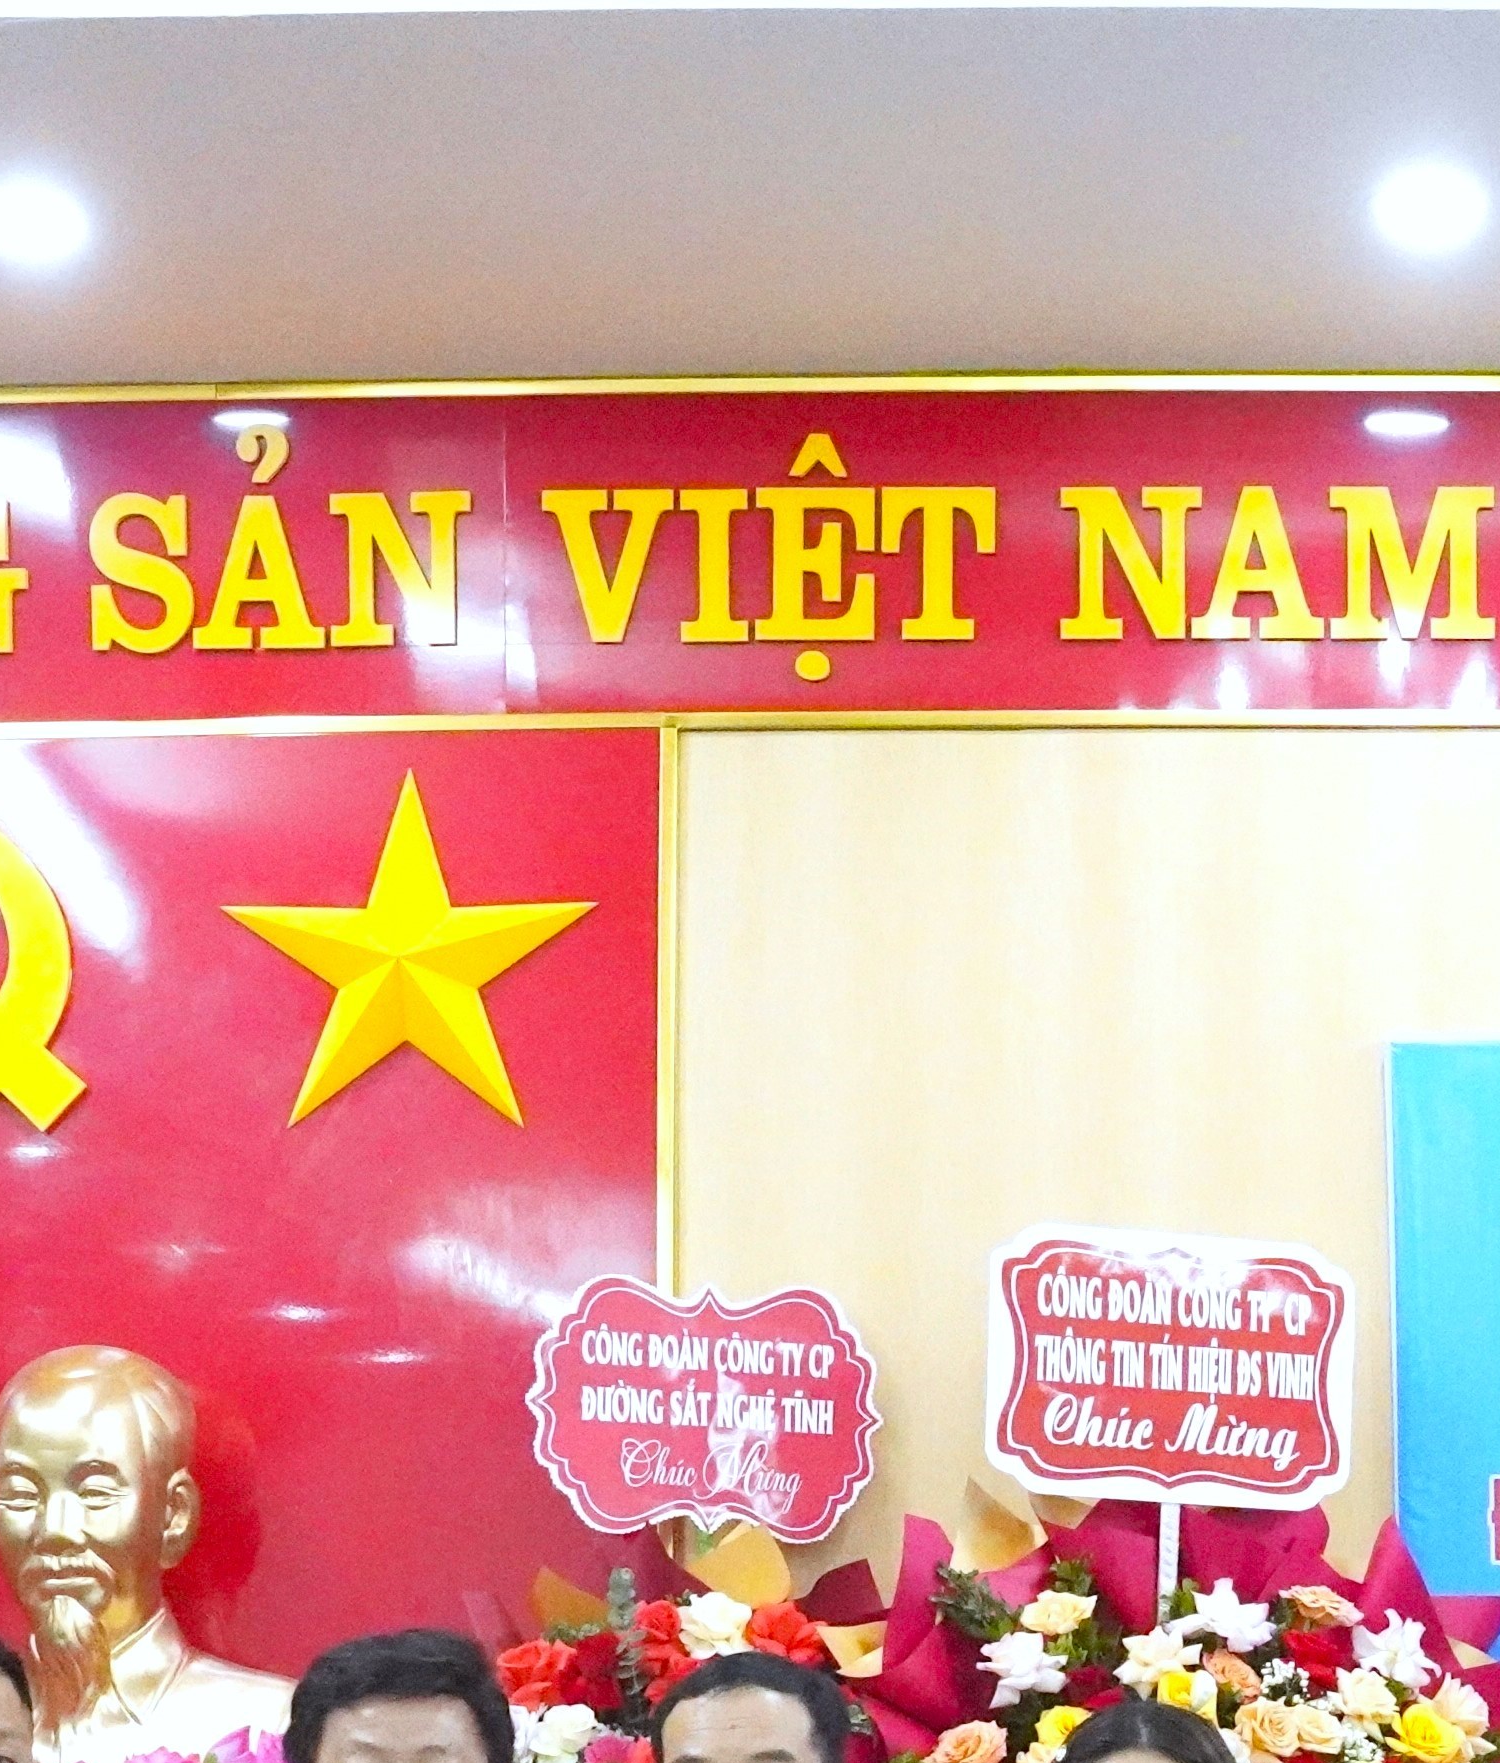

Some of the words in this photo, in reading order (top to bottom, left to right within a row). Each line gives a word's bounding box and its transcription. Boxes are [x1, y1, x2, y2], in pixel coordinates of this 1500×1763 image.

[91, 423, 470, 653] SẢN
[542, 433, 995, 681] VIỆT
[1059, 486, 1495, 644] NAM
[1037, 1265, 1102, 1319] CÔNG
[1108, 1272, 1173, 1325] ĐOÀN
[1247, 1290, 1276, 1333] TY
[1284, 1293, 1312, 1336] CP
[582, 1323, 643, 1367] CÔNG
[649, 1329, 708, 1370] ĐOÀN
[714, 1332, 774, 1375] CÔNG
[779, 1342, 804, 1377] TY
[809, 1345, 835, 1379] CP
[1035, 1327, 1106, 1384] THÔNG
[1111, 1340, 1145, 1388] TIN
[1150, 1333, 1183, 1391] TÍN
[1188, 1337, 1234, 1403] HIỆU
[1236, 1350, 1262, 1397] ĐS
[1266, 1352, 1316, 1401] VINH
[581, 1380, 664, 1424] ĐƯỜNG
[670, 1378, 711, 1427] SẮT
[717, 1389, 775, 1440] NGHỆ
[1044, 1393, 1154, 1450] Chúc
[1164, 1402, 1300, 1472] Mừng
[620, 1438, 697, 1487] Chúc
